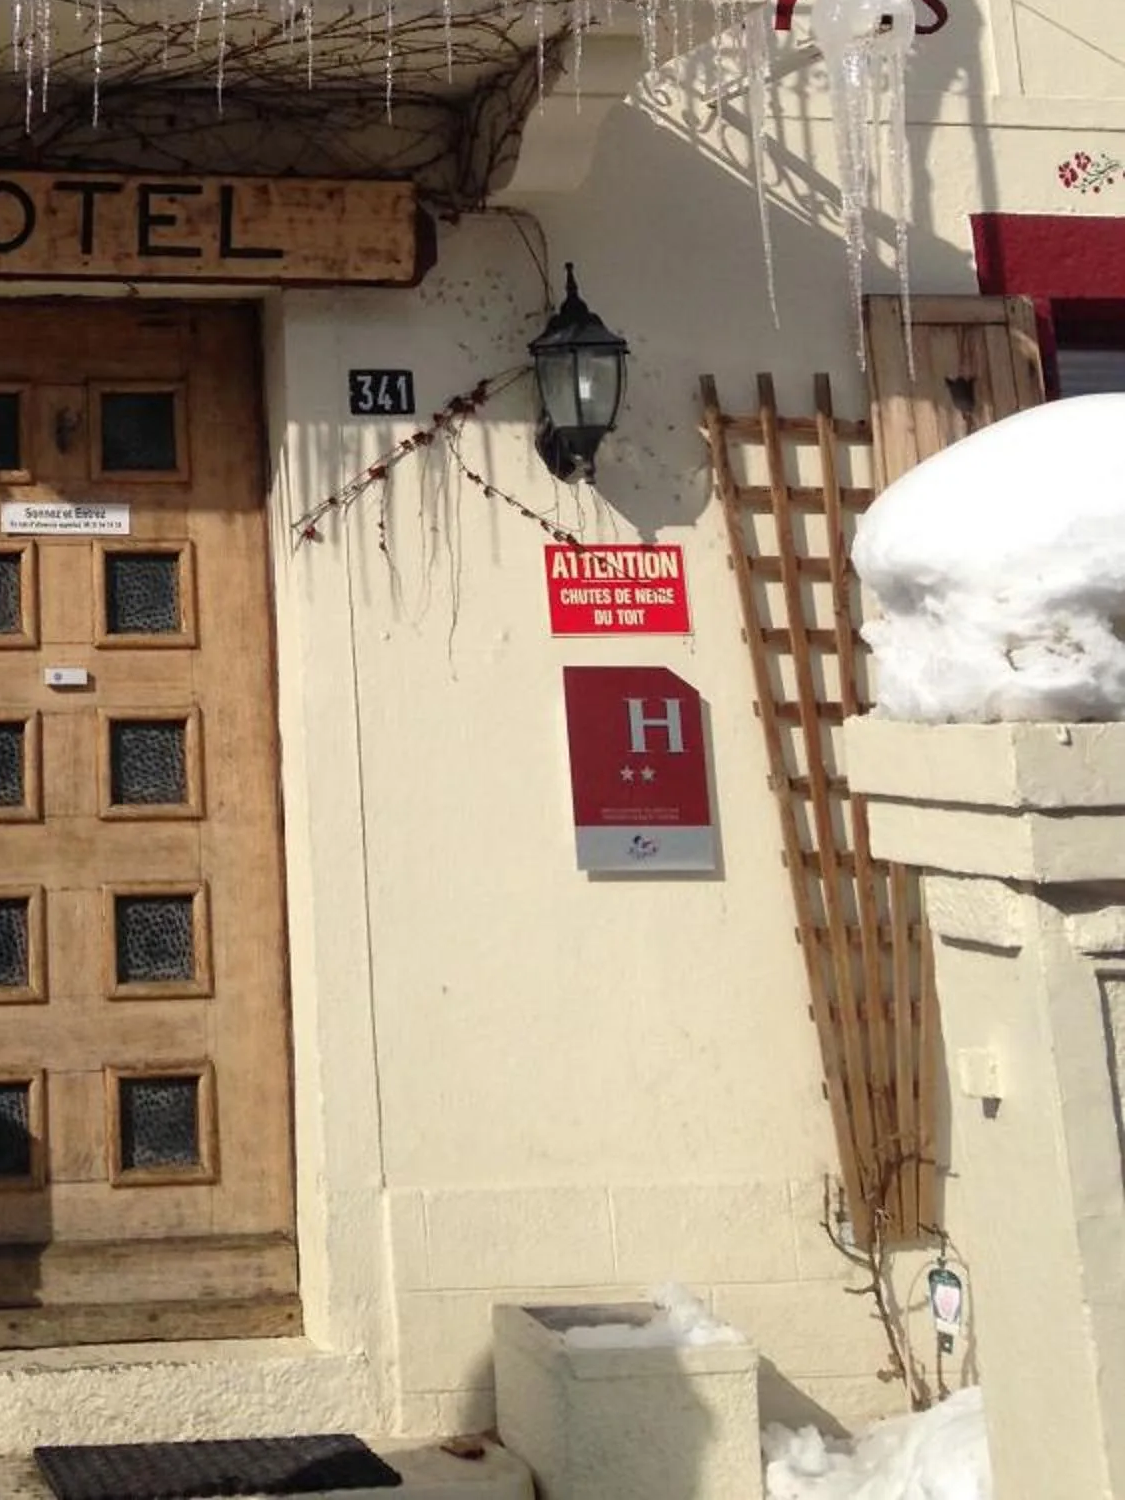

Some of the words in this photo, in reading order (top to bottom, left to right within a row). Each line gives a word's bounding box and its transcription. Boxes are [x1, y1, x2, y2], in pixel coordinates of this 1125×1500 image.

[356, 375, 408, 411] 341
[552, 551, 678, 579] ATTENTION
[560, 588, 611, 605] CHUTES
[615, 588, 633, 605] DE
[635, 588, 675, 605] NEIGE
[594, 609, 612, 626] DU
[616, 609, 645, 626] TOIT
[623, 698, 690, 753] H
